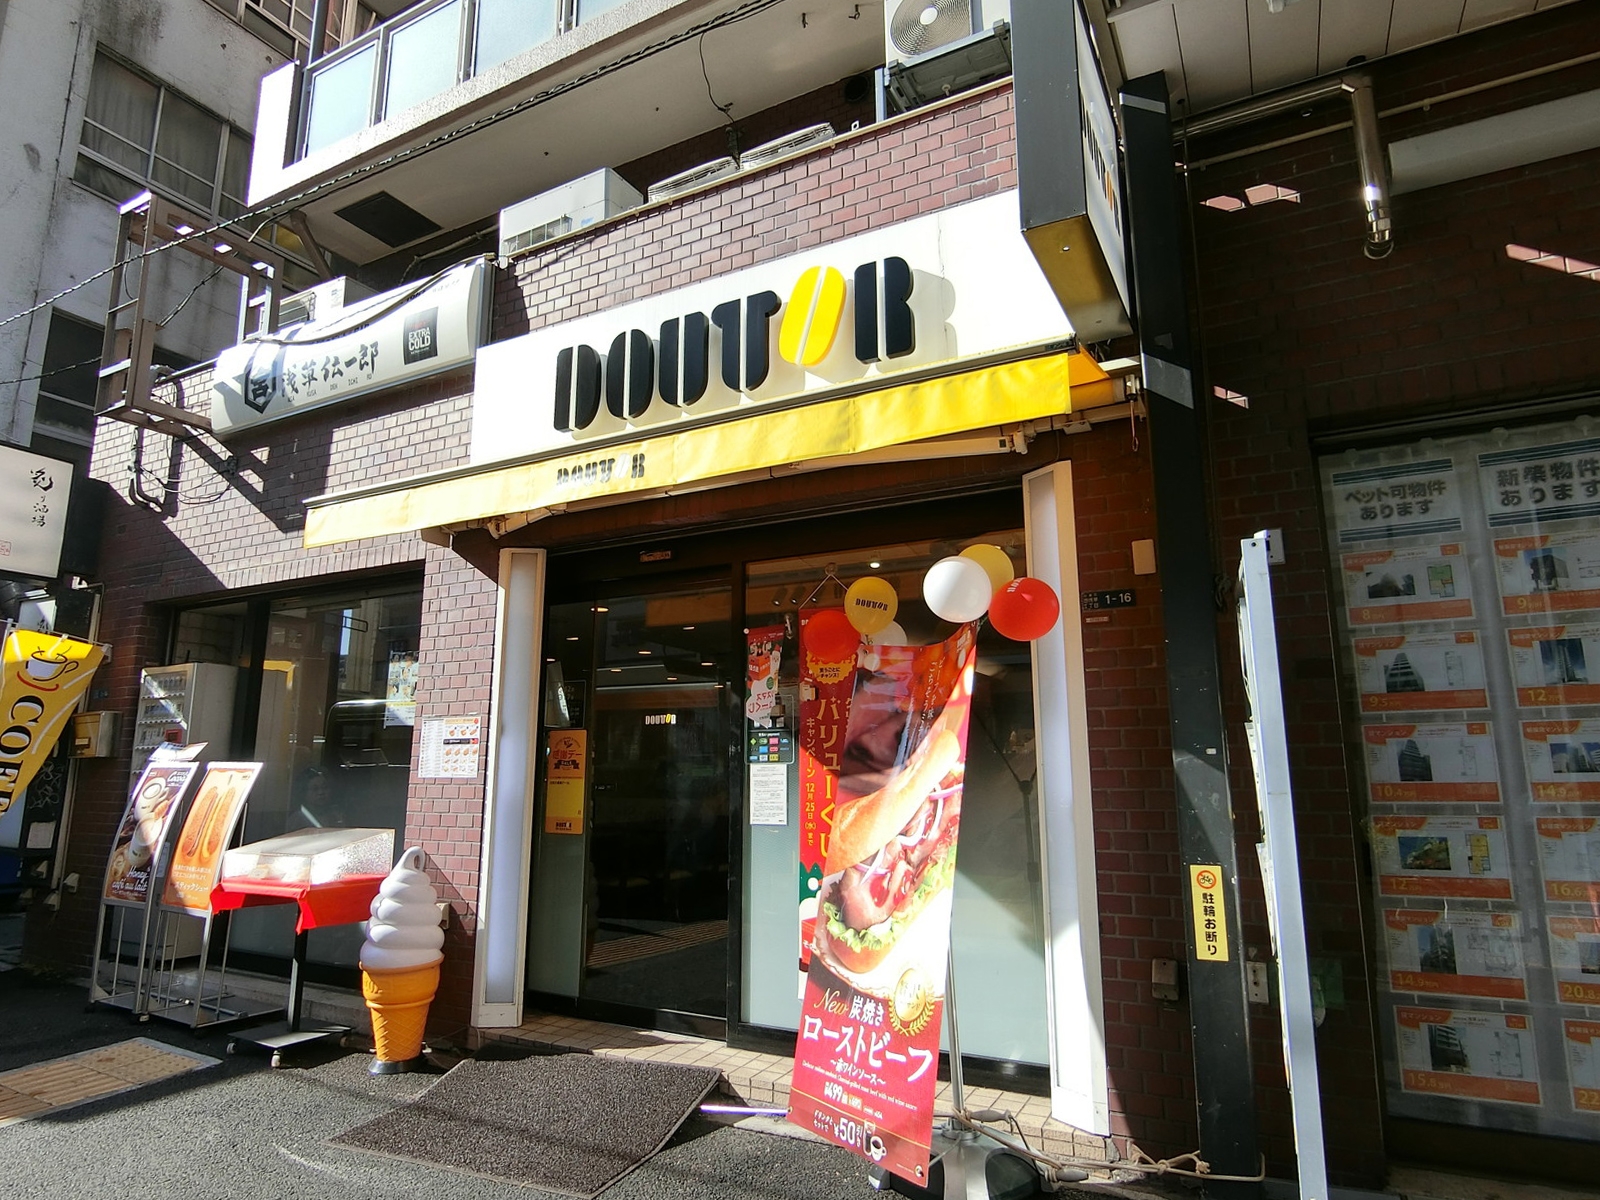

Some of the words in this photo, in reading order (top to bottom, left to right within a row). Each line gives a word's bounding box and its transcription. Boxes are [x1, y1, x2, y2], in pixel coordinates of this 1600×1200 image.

[408, 326, 431, 340] EXTRA
[408, 335, 431, 351] COLD
[553, 255, 916, 433] DOUTOR
[282, 340, 379, 397] 浅草伝一郎
[556, 452, 646, 488] DOUTOR
[1497, 457, 1600, 487] 新築物件
[1344, 479, 1447, 504] ペット可物件
[1501, 479, 1600, 507] あります
[1360, 498, 1434, 521] あります
[1105, 592, 1132, 605] 1-16
[645, 713, 676, 726] DOUTOR
[806, 716, 817, 779] キャンペーン
[1202, 892, 1218, 956] 駐輪お断り
[813, 987, 848, 1016] New
[848, 995, 885, 1027] 炭焼き
[803, 1014, 934, 1083] ローストビーフ
